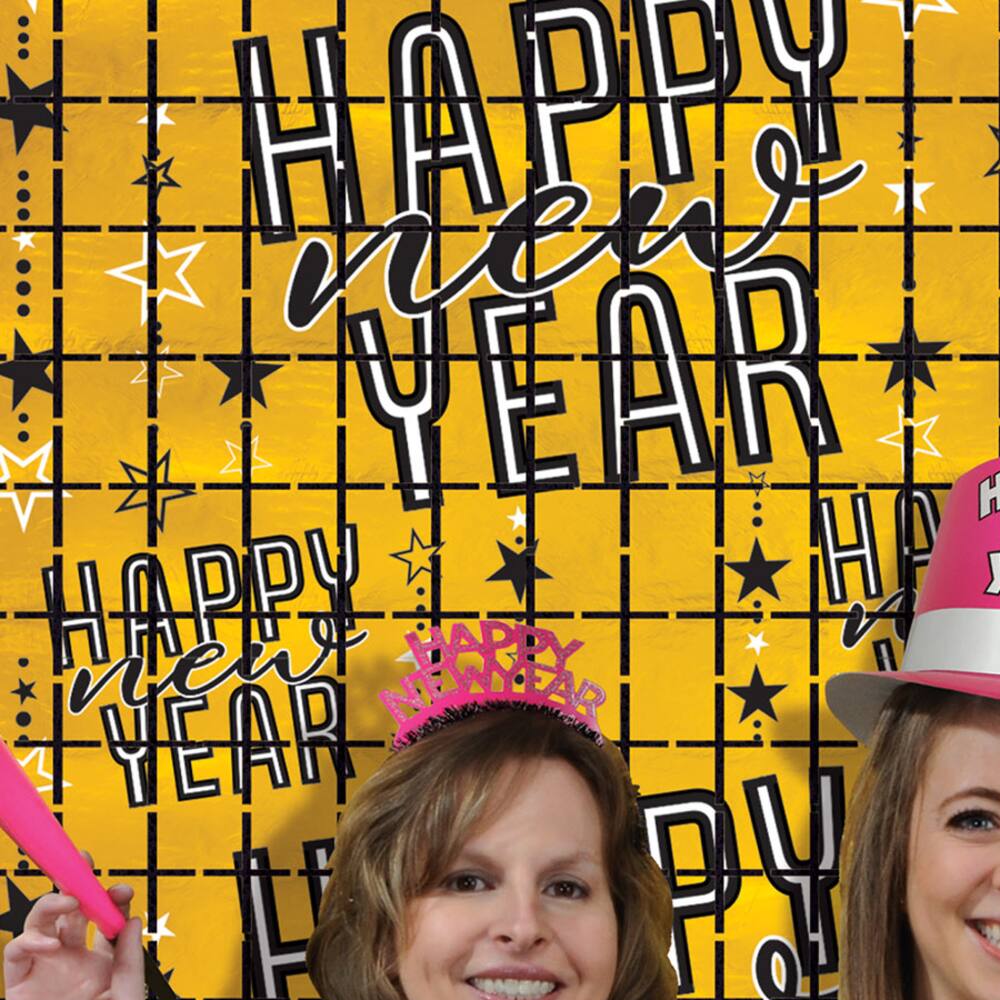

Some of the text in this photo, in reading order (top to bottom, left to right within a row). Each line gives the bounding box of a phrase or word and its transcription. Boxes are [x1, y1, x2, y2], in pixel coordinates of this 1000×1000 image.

[233, 0, 849, 245] HAPPY
[284, 124, 868, 331] new
[346, 253, 843, 512] YEAR
[41, 523, 360, 669] HAPPY
[67, 611, 369, 716] new
[404, 620, 585, 672] HAPPY
[99, 674, 357, 809] YEAR
[378, 656, 607, 727] NEW YEAR
